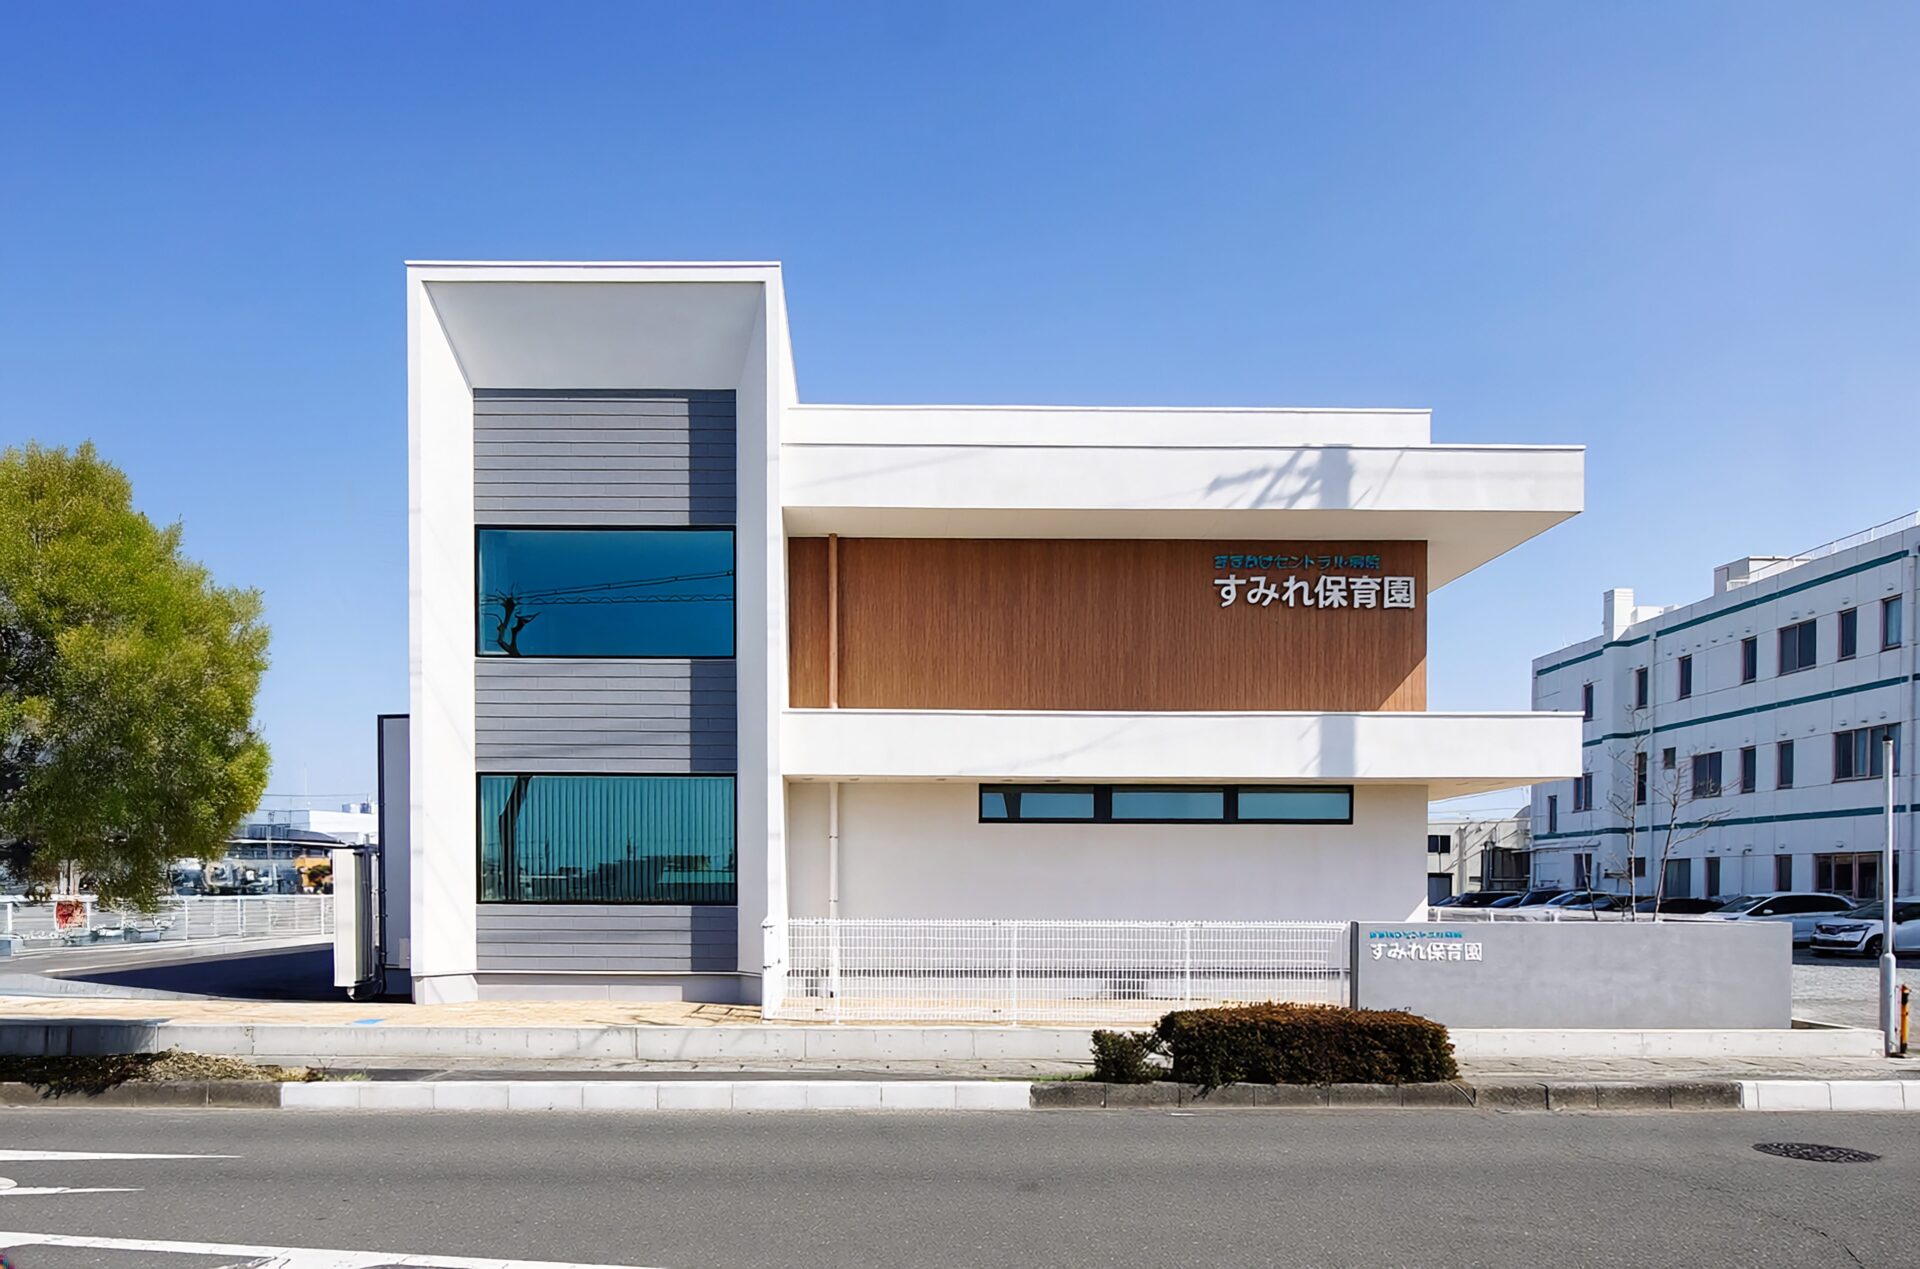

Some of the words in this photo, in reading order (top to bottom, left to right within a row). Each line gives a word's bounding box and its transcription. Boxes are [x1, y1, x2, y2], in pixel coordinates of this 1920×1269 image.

[1214, 574, 1416, 609] すみれ保育園
[1369, 942, 1483, 961] すみれ保育園
